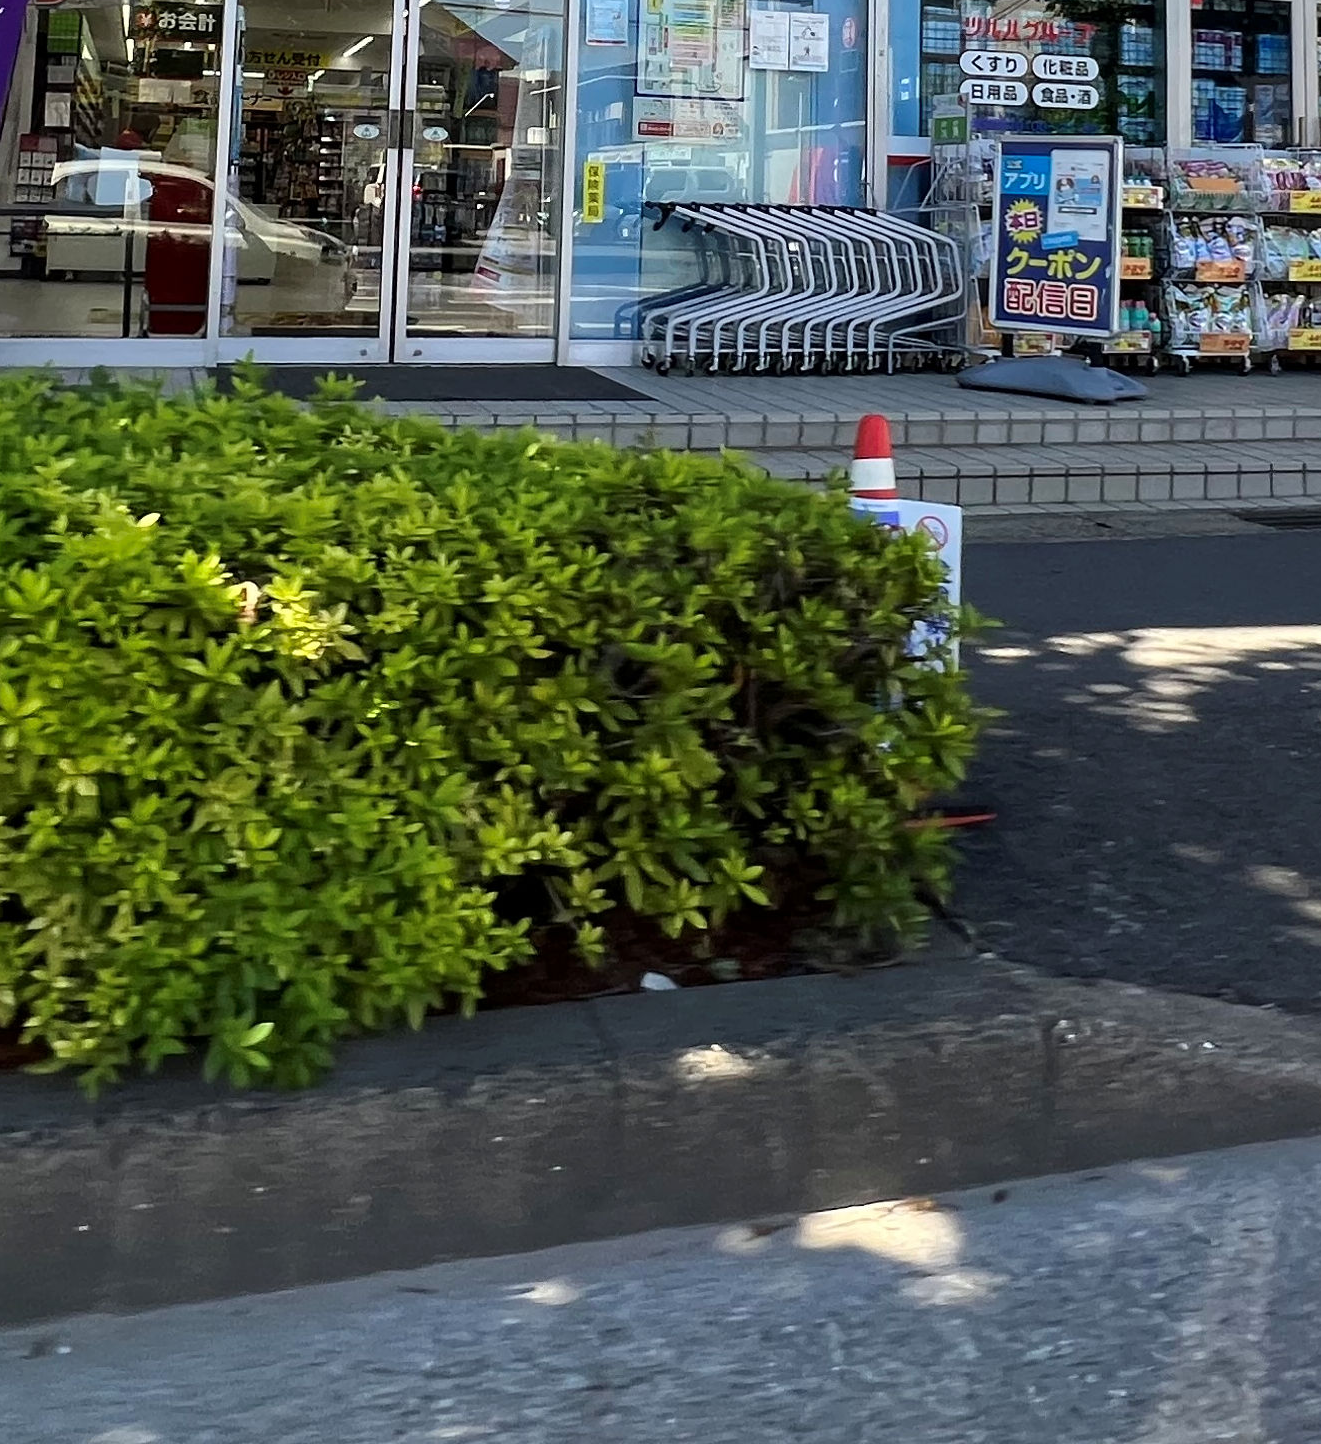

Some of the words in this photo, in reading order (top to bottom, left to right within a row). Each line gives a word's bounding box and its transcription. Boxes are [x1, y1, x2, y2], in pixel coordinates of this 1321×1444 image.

[158, 11, 217, 33] お会計
[245, 51, 322, 67] 方せん受付
[970, 54, 1018, 77] くすり
[1043, 58, 1089, 78] 化粧品
[970, 83, 1018, 102] 日用品
[1040, 86, 1092, 106] 食品・酒
[1003, 171, 1046, 190] アプリ
[1008, 211, 1039, 230] 本日
[1006, 246, 1102, 279] クーポン
[1005, 278, 1098, 321] 配信日
